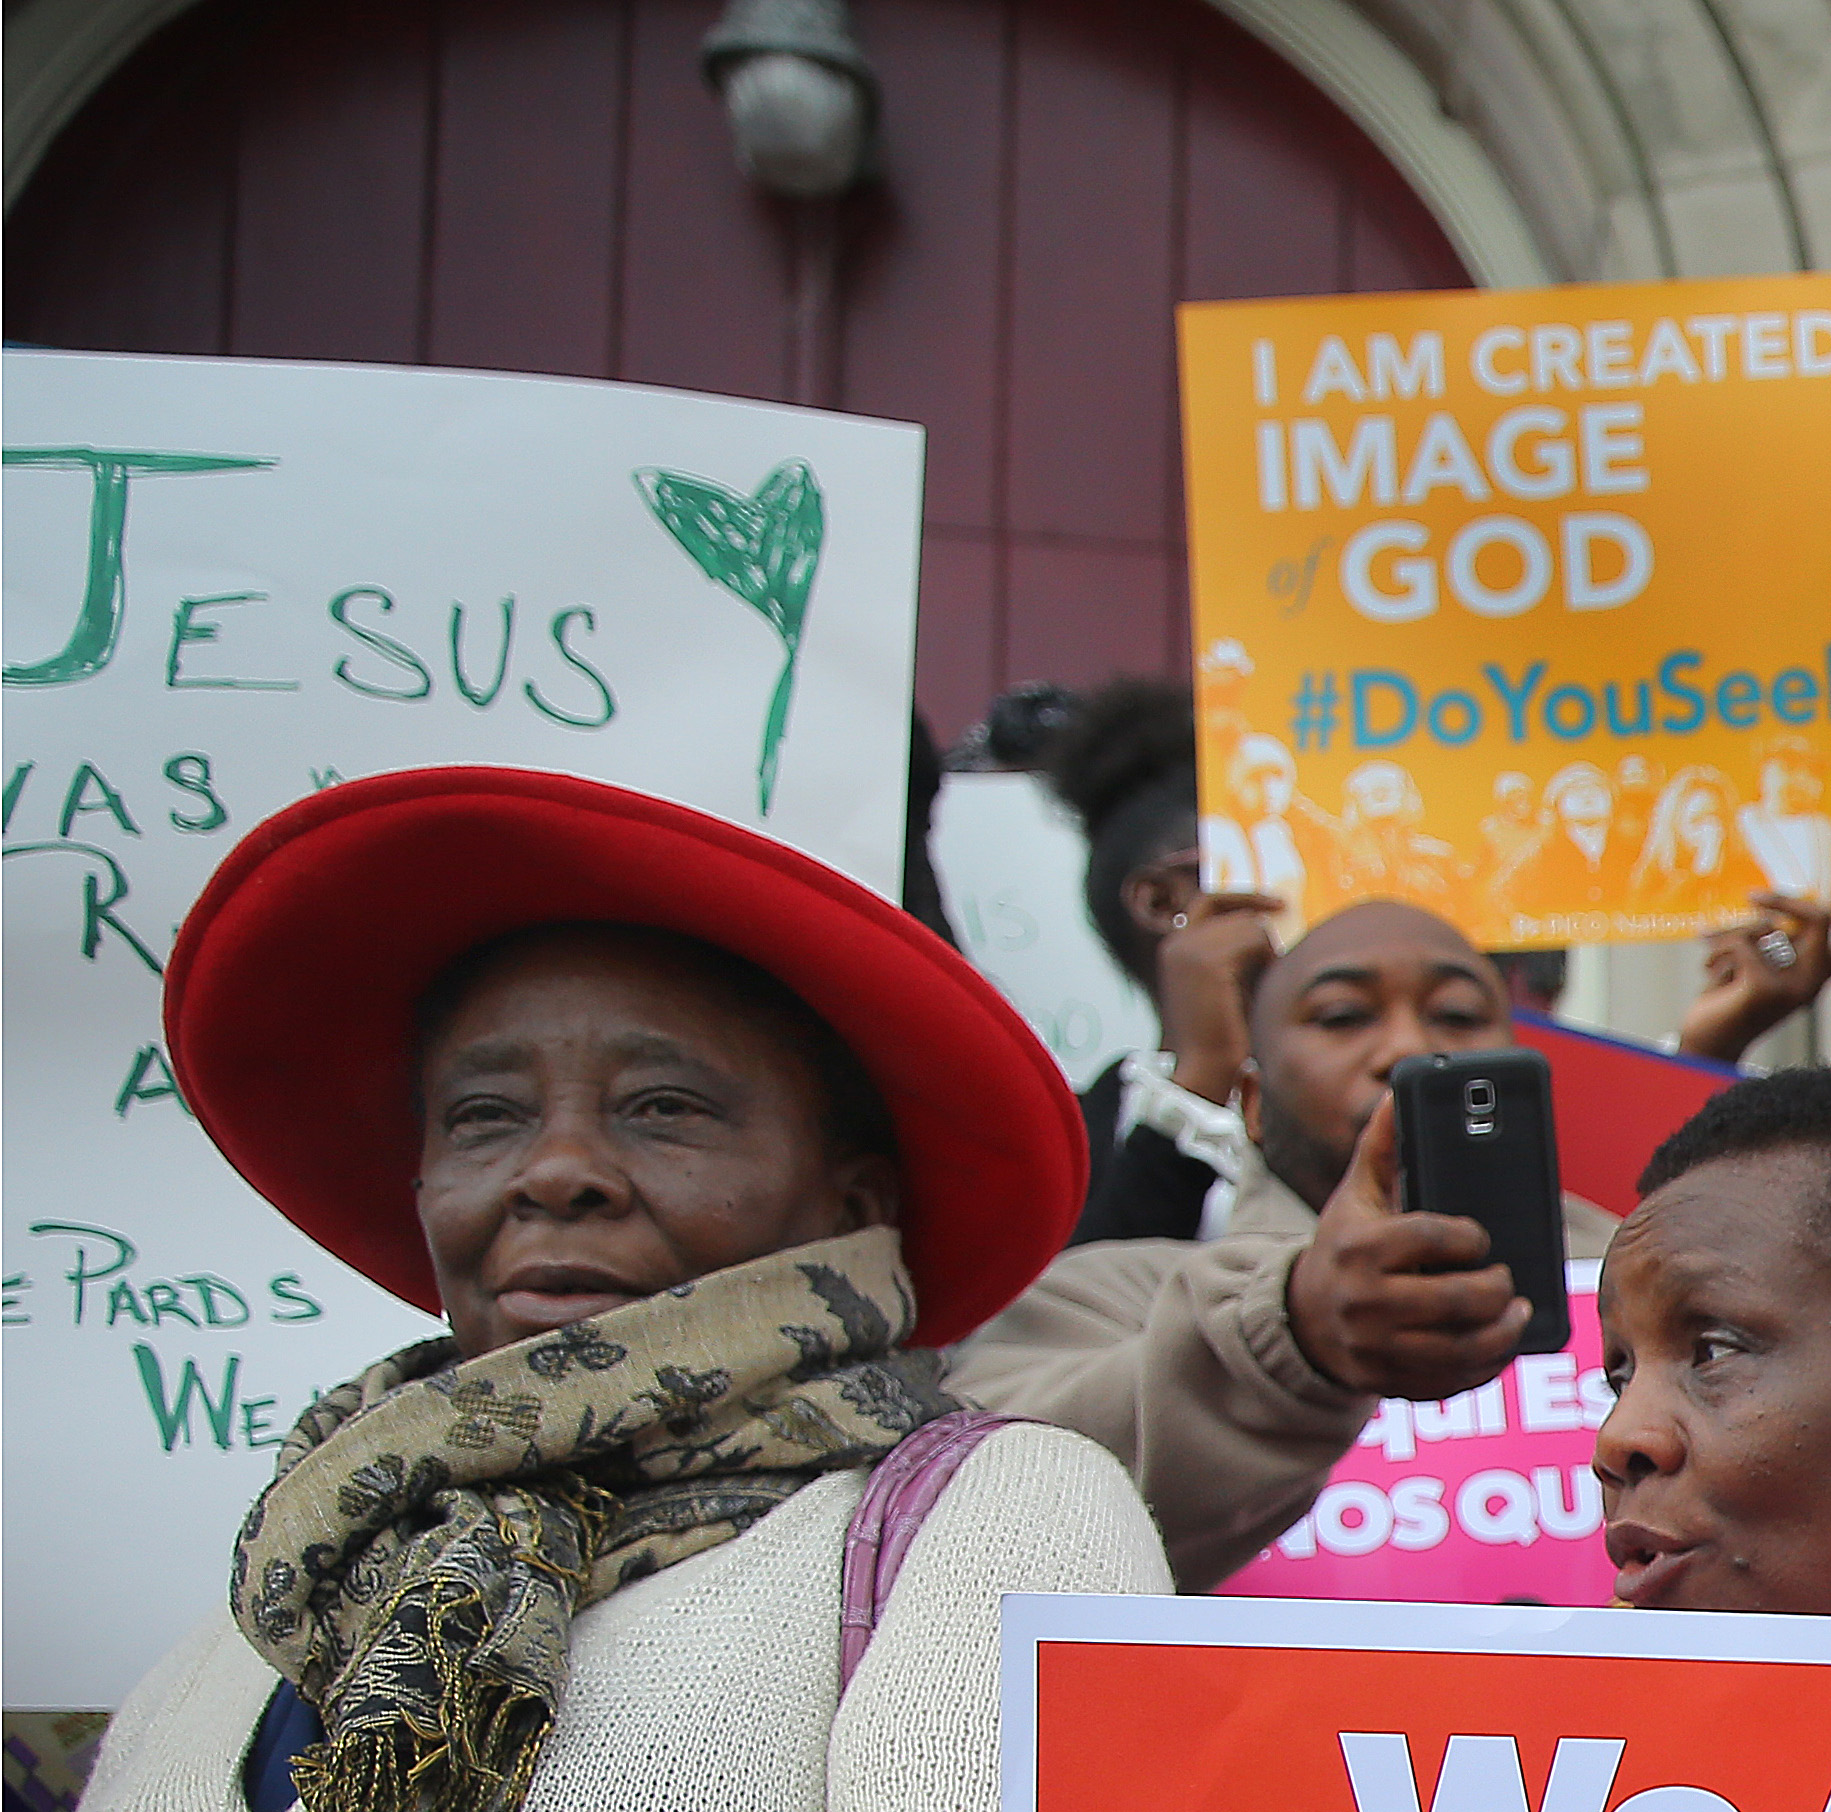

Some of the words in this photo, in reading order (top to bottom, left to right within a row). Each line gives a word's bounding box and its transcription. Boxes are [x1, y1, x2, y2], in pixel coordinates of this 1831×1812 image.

[1253, 337, 1277, 405] I
[1301, 328, 1445, 402] AM
[1254, 402, 1650, 512] IMAGE
[3, 443, 617, 728] JESUS
[1340, 509, 1656, 623] GOD
